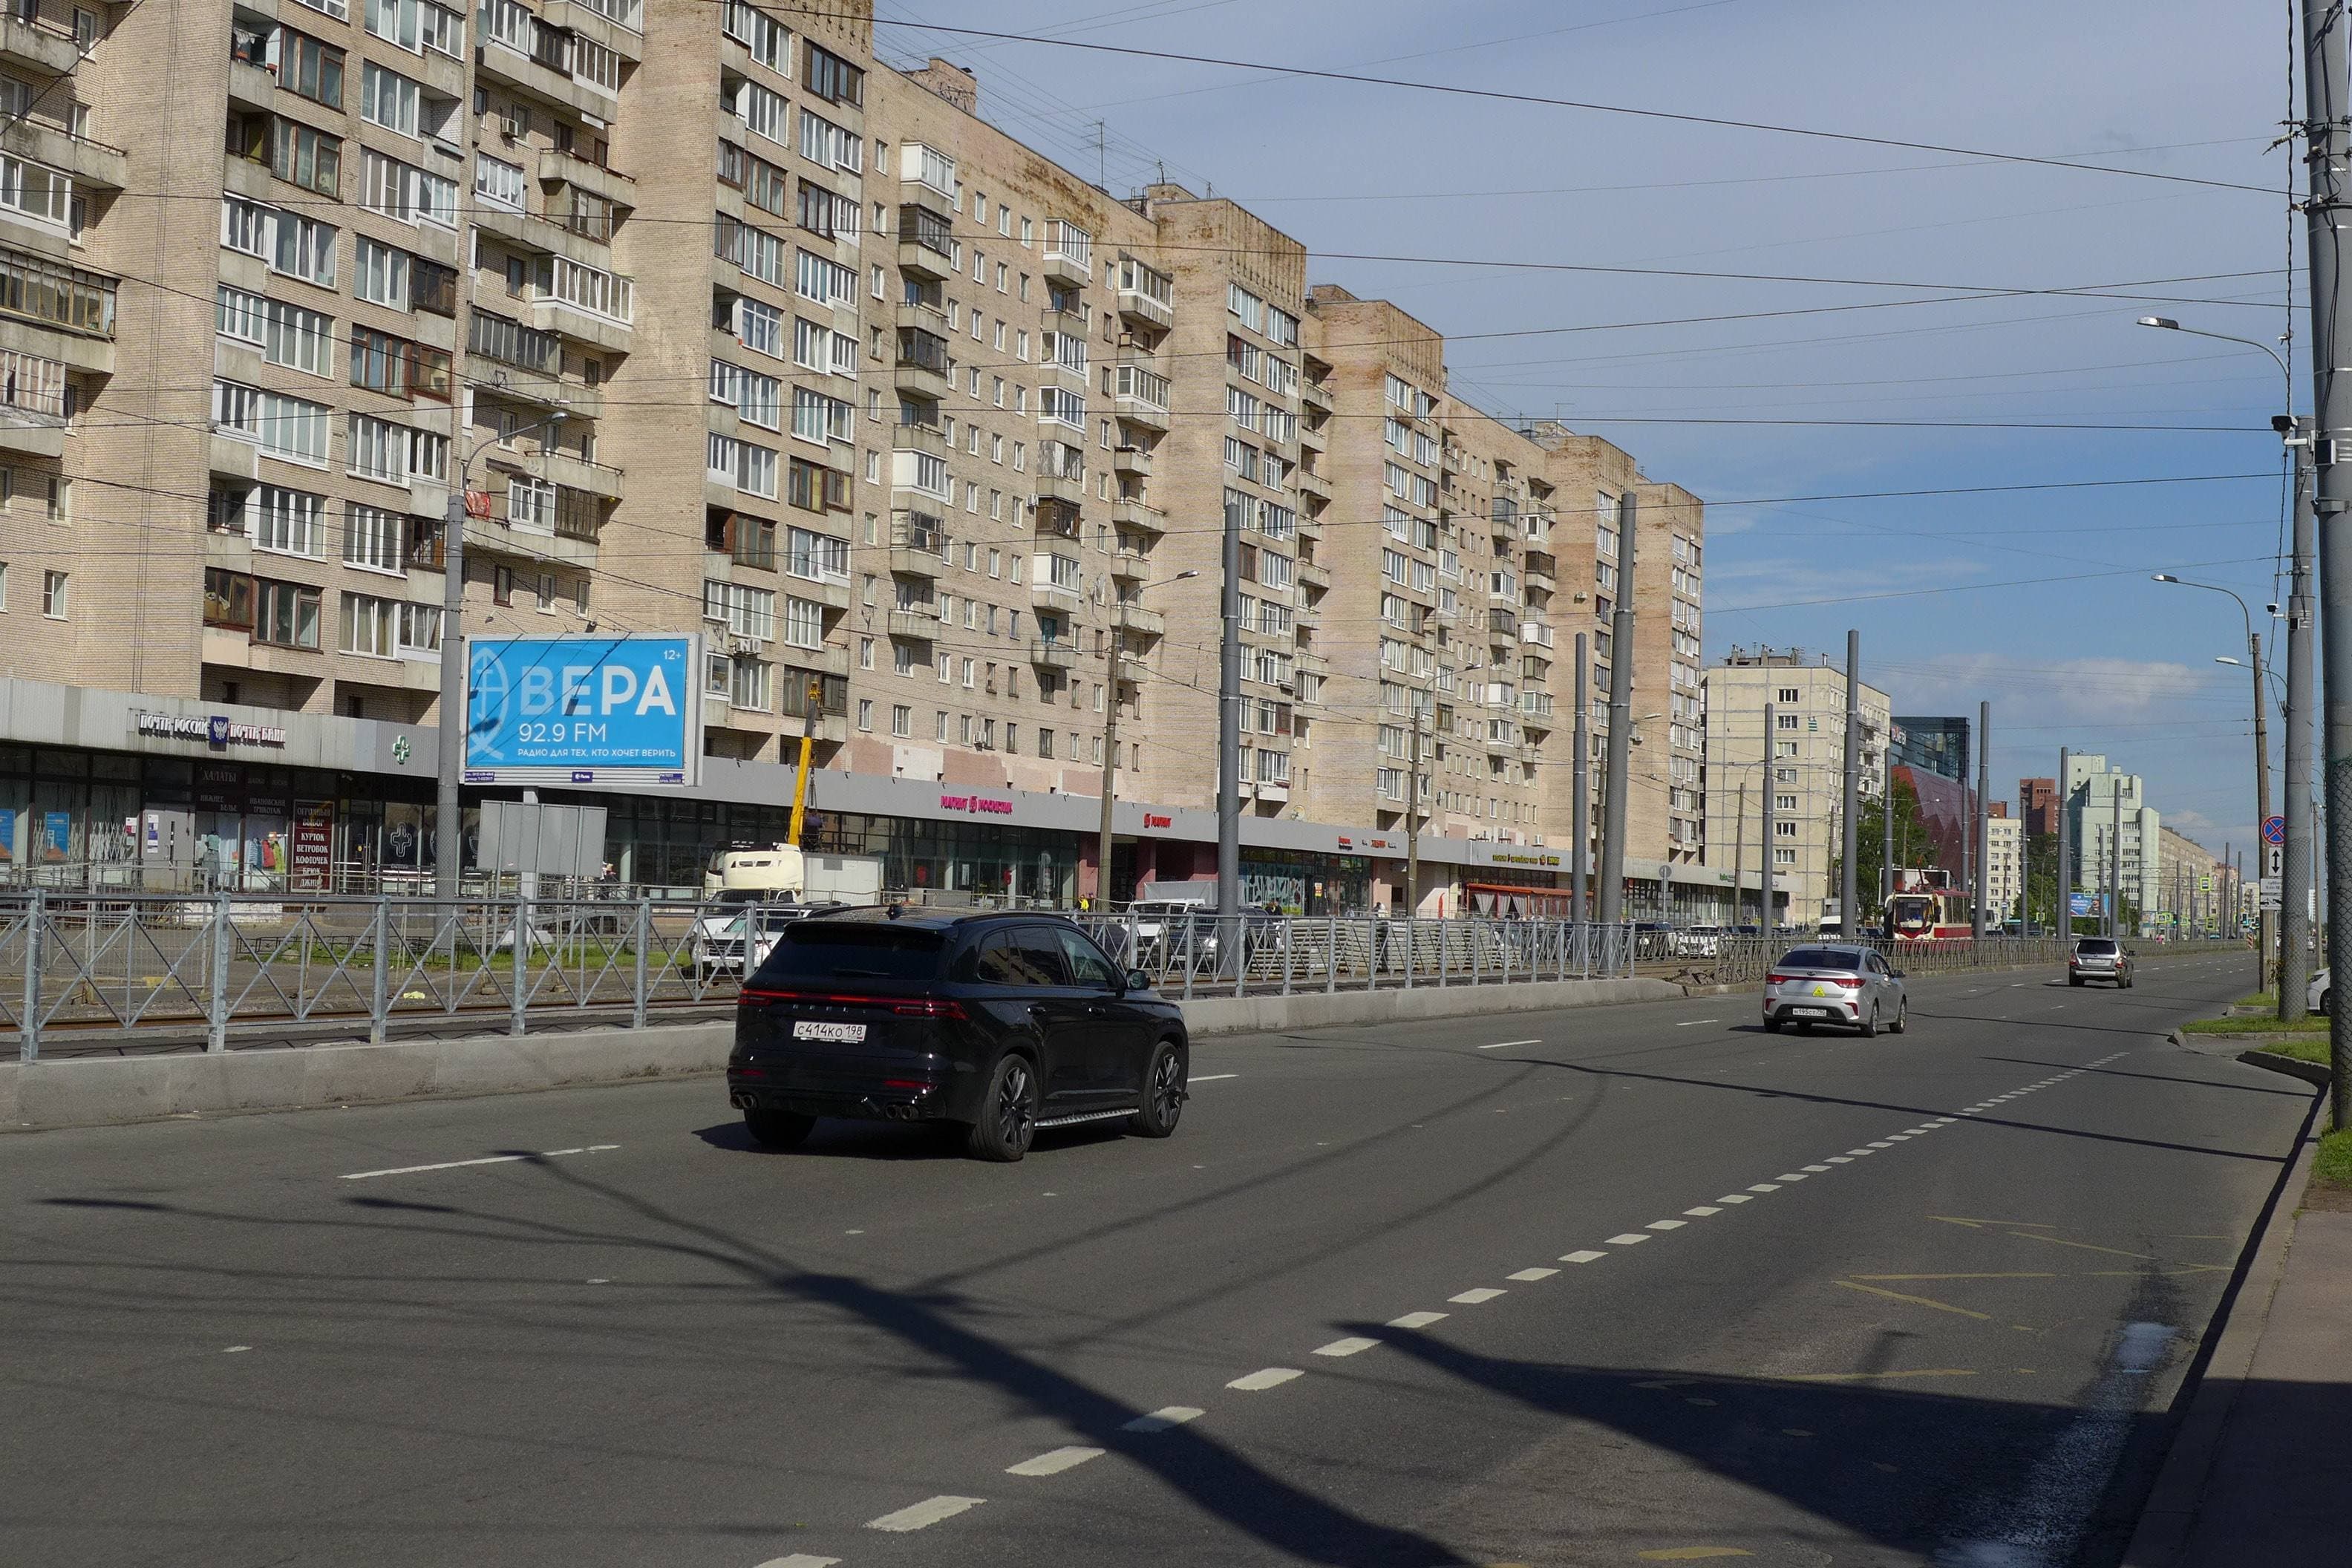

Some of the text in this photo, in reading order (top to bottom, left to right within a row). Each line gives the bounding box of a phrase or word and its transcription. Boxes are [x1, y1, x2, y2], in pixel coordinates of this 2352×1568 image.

[664, 650, 682, 661] 12+
[520, 664, 677, 716] ВЕРА
[519, 723, 607, 743] 92.9 FM
[517, 748, 676, 757] РАДИО ДЛЯ ТЕХ, КТО ХОЧЕТ ВЕРИТЬ
[203, 770, 237, 782] ХАЛАТЫ
[253, 806, 281, 814] ТРИКОТАЖ
[302, 818, 324, 827] ВЫБОР
[301, 833, 325, 842] КУРТОК
[296, 844, 328, 853] ВЕТРОВОК
[295, 855, 328, 865] КОФТОЧЕК
[302, 867, 321, 875] БРЮК
[797, 1024, 863, 1037] С414КО 198
